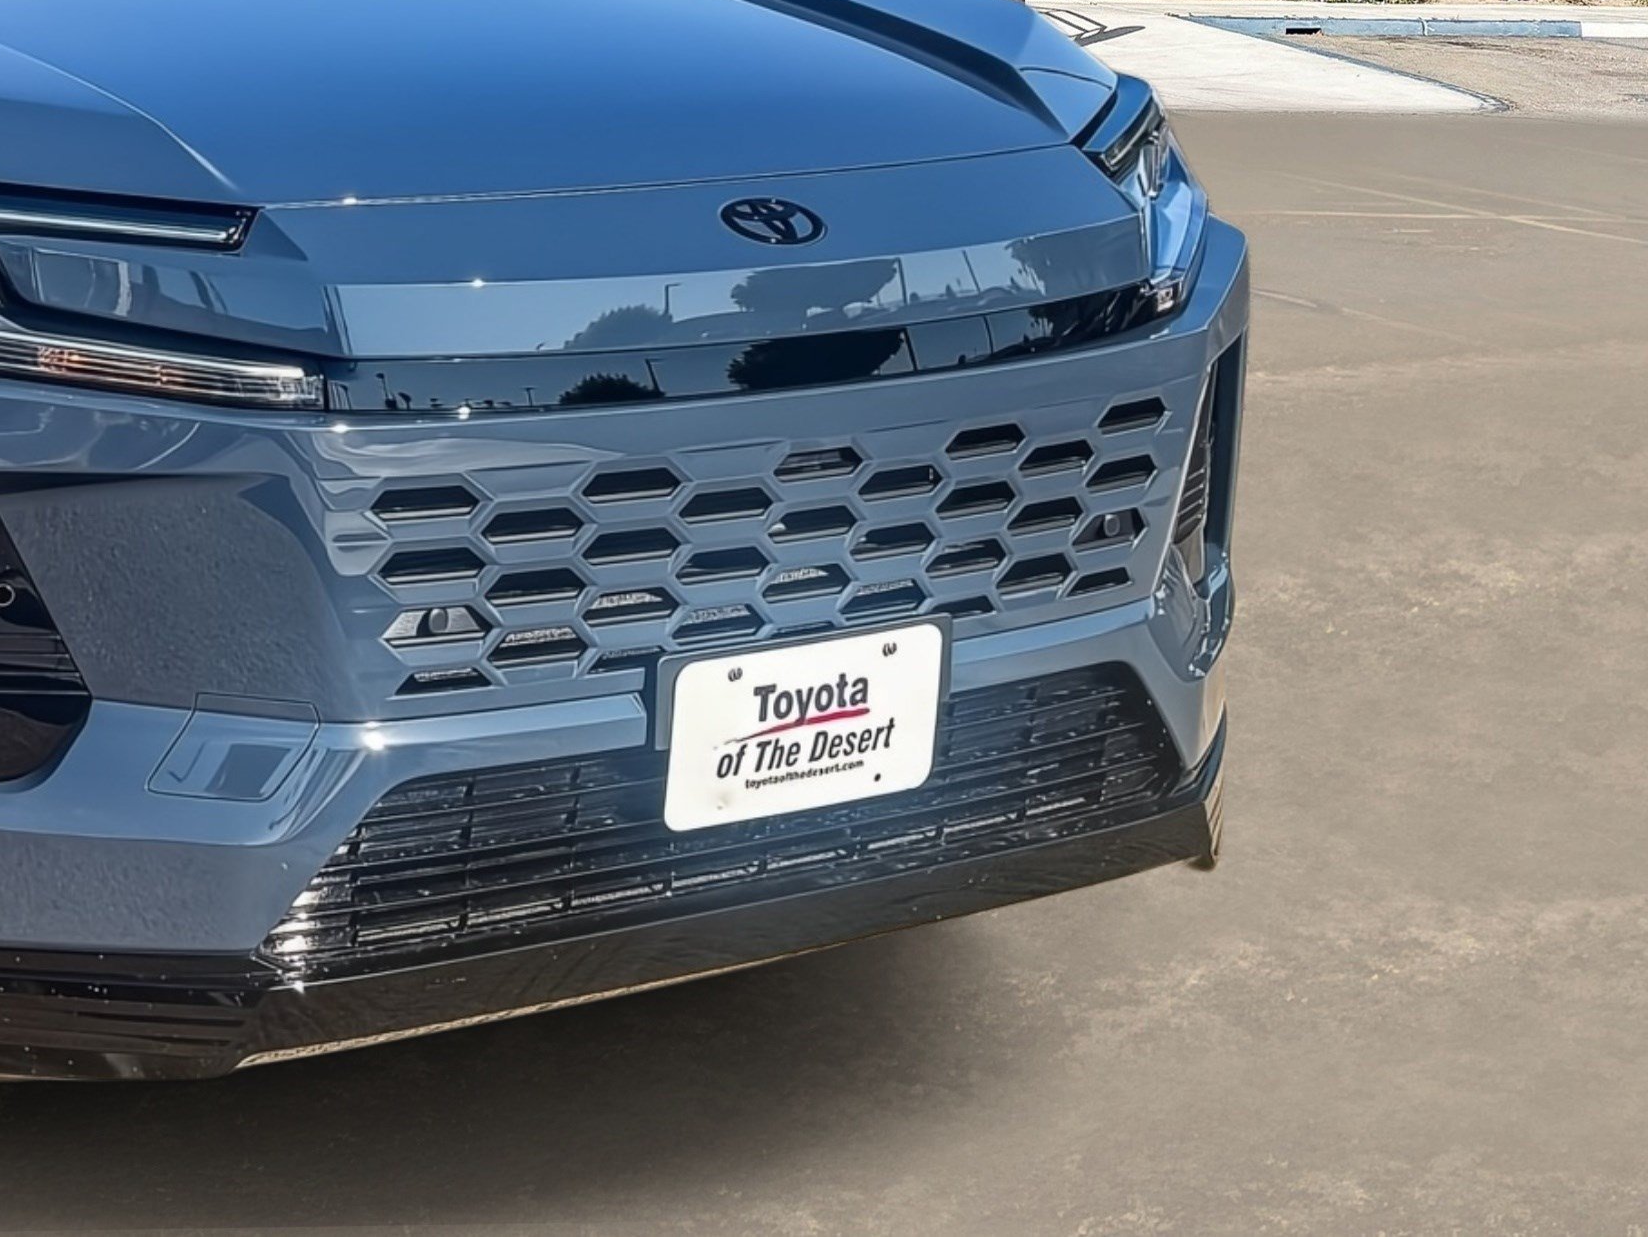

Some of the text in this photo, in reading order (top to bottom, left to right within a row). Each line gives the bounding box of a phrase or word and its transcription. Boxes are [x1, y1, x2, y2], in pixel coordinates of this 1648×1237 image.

[754, 673, 869, 725] Toyota
[716, 717, 895, 779] of The Desert
